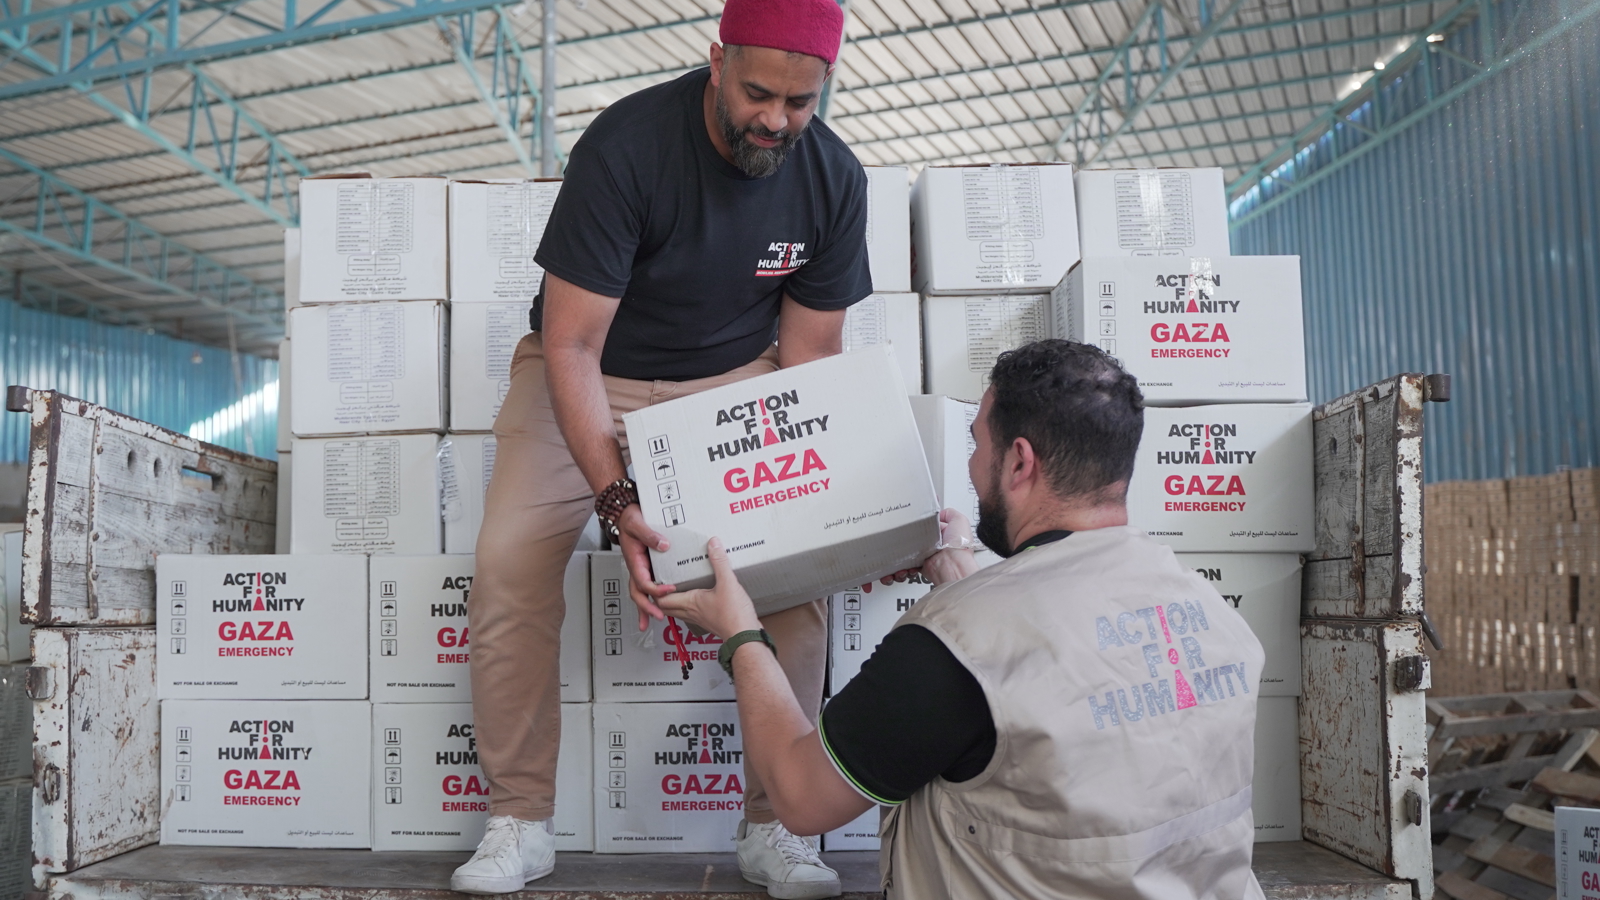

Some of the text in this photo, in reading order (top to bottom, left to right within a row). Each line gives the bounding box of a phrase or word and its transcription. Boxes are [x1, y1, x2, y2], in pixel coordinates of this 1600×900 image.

[768, 242, 805, 253] ACTION
[758, 259, 810, 268] HUMANITY
[1144, 299, 1240, 314] HUMANITY
[1150, 323, 1230, 343] GAZA
[1151, 348, 1230, 358] EMERGENCY
[716, 390, 799, 426] ACTION
[707, 414, 829, 462] HUMANITY
[1168, 424, 1236, 439] ACTION
[1157, 450, 1256, 464] HUMANITY
[724, 448, 827, 493] GAZA
[1164, 475, 1246, 496] GAZA
[730, 478, 830, 514] EMERGENCY
[1164, 502, 1246, 512] EMERGENCY
[732, 540, 765, 552] EXCHANGE
[223, 572, 286, 586] ACTION
[442, 576, 474, 589] ACT
[212, 597, 304, 612] HUMANITY
[218, 621, 294, 641] GAZA
[1096, 600, 1209, 650] ACTION
[218, 647, 294, 657] EMERGENCY
[1088, 662, 1249, 730] HUMANITY
[229, 720, 294, 735] ACTION
[666, 724, 734, 738] ACTION
[218, 745, 312, 760] HUMANITY
[655, 749, 742, 764] HUMANIT
[224, 770, 301, 790] GAZA
[661, 774, 743, 794] GAZA
[224, 796, 301, 806] EMERGENCY
[662, 801, 743, 811] EMERGENCY
[1584, 826, 1600, 839] ACT
[1582, 871, 1600, 892] GA
